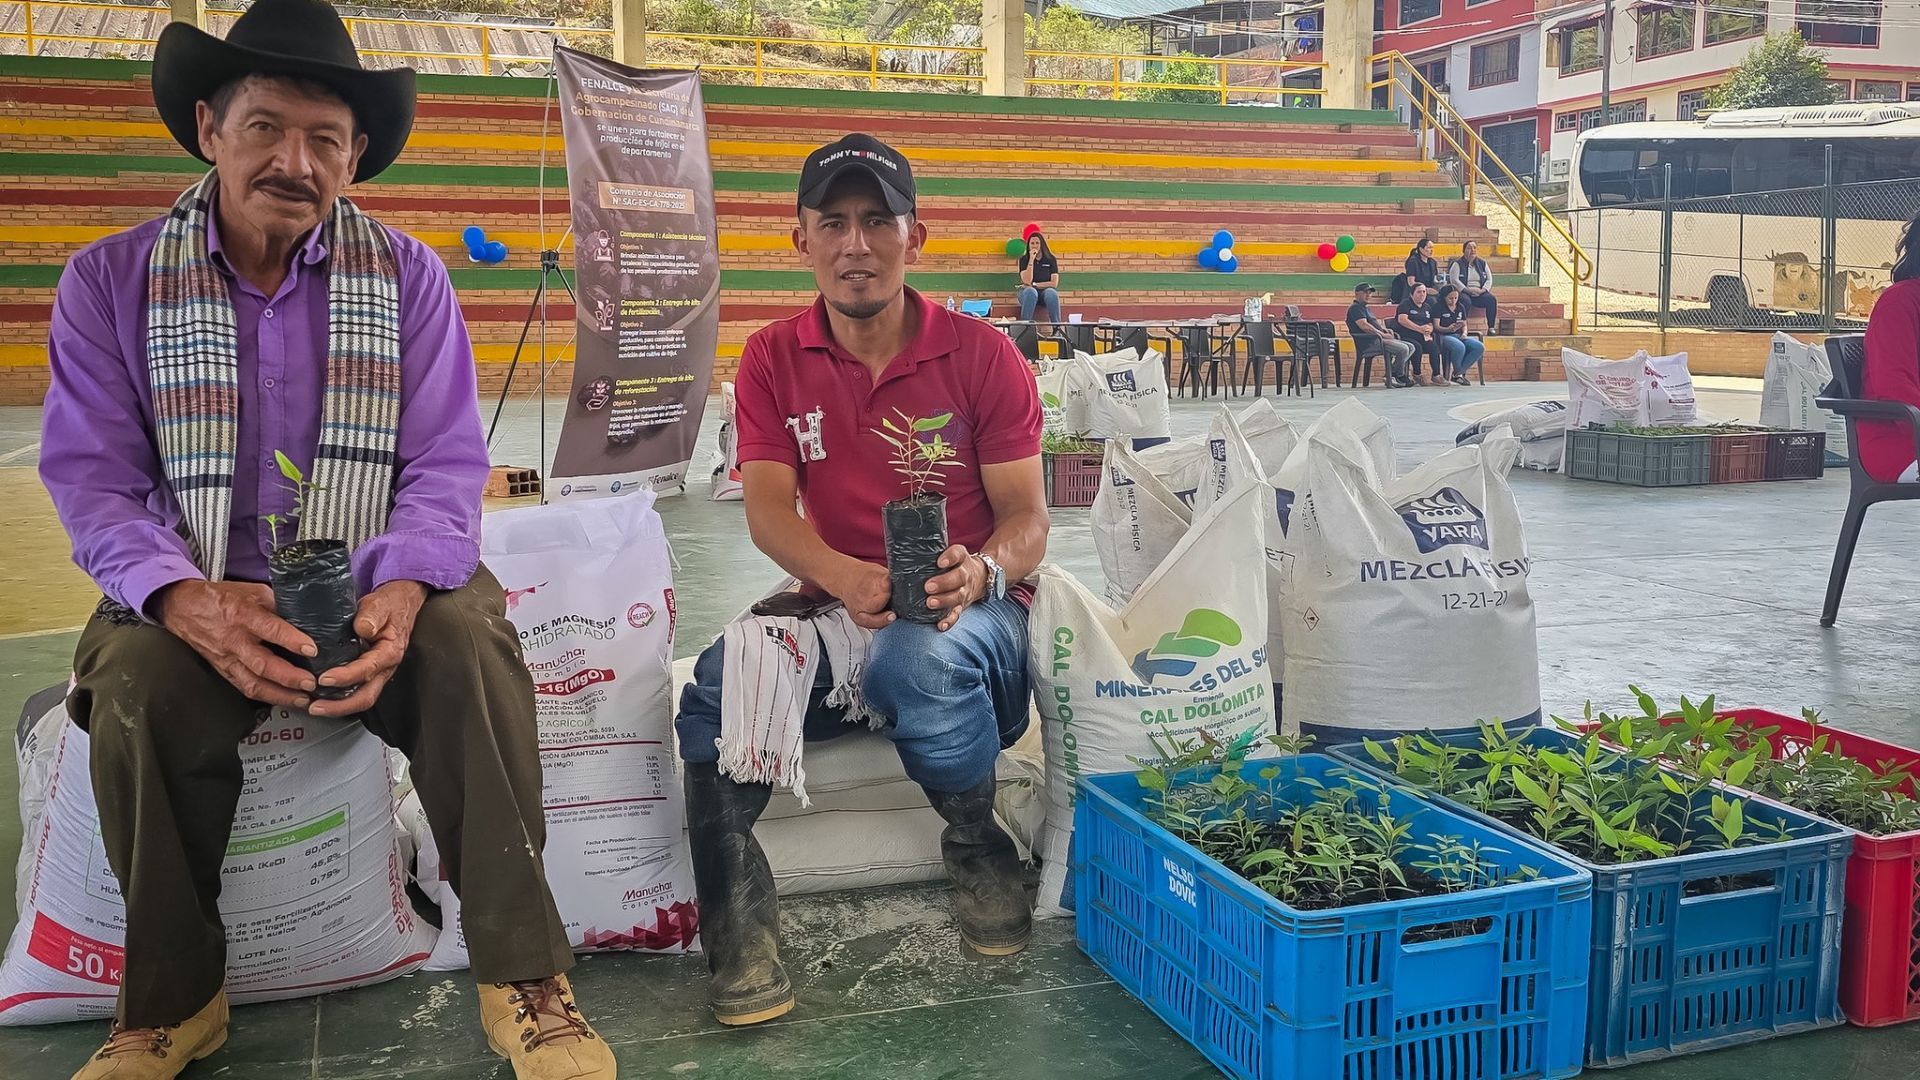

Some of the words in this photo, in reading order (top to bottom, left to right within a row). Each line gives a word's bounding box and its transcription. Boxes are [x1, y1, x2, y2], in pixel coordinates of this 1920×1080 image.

[581, 77, 625, 92] FENALCE
[571, 105, 634, 121] Gobernación
[636, 112, 647, 123] de
[658, 101, 679, 117] (SAG)
[597, 123, 607, 131] se
[607, 125, 628, 134] unen
[629, 127, 647, 136] para
[600, 134, 643, 146] producción
[644, 138, 654, 147] de
[621, 146, 672, 159] departamento
[1422, 524, 1483, 543] YARA
[1361, 557, 1481, 583] MEZCLA
[532, 623, 549, 637] DE
[551, 614, 617, 631] MAGNESIO
[1053, 626, 1074, 677] CAL
[1215, 657, 1252, 684] DEL
[1140, 708, 1179, 726] CAL
[1184, 684, 1265, 721] DOLOMITA
[222, 864, 255, 875] AGUA
[621, 881, 673, 902] Manuchar
[66, 944, 105, 980] 50
[238, 949, 266, 961] LOTE
